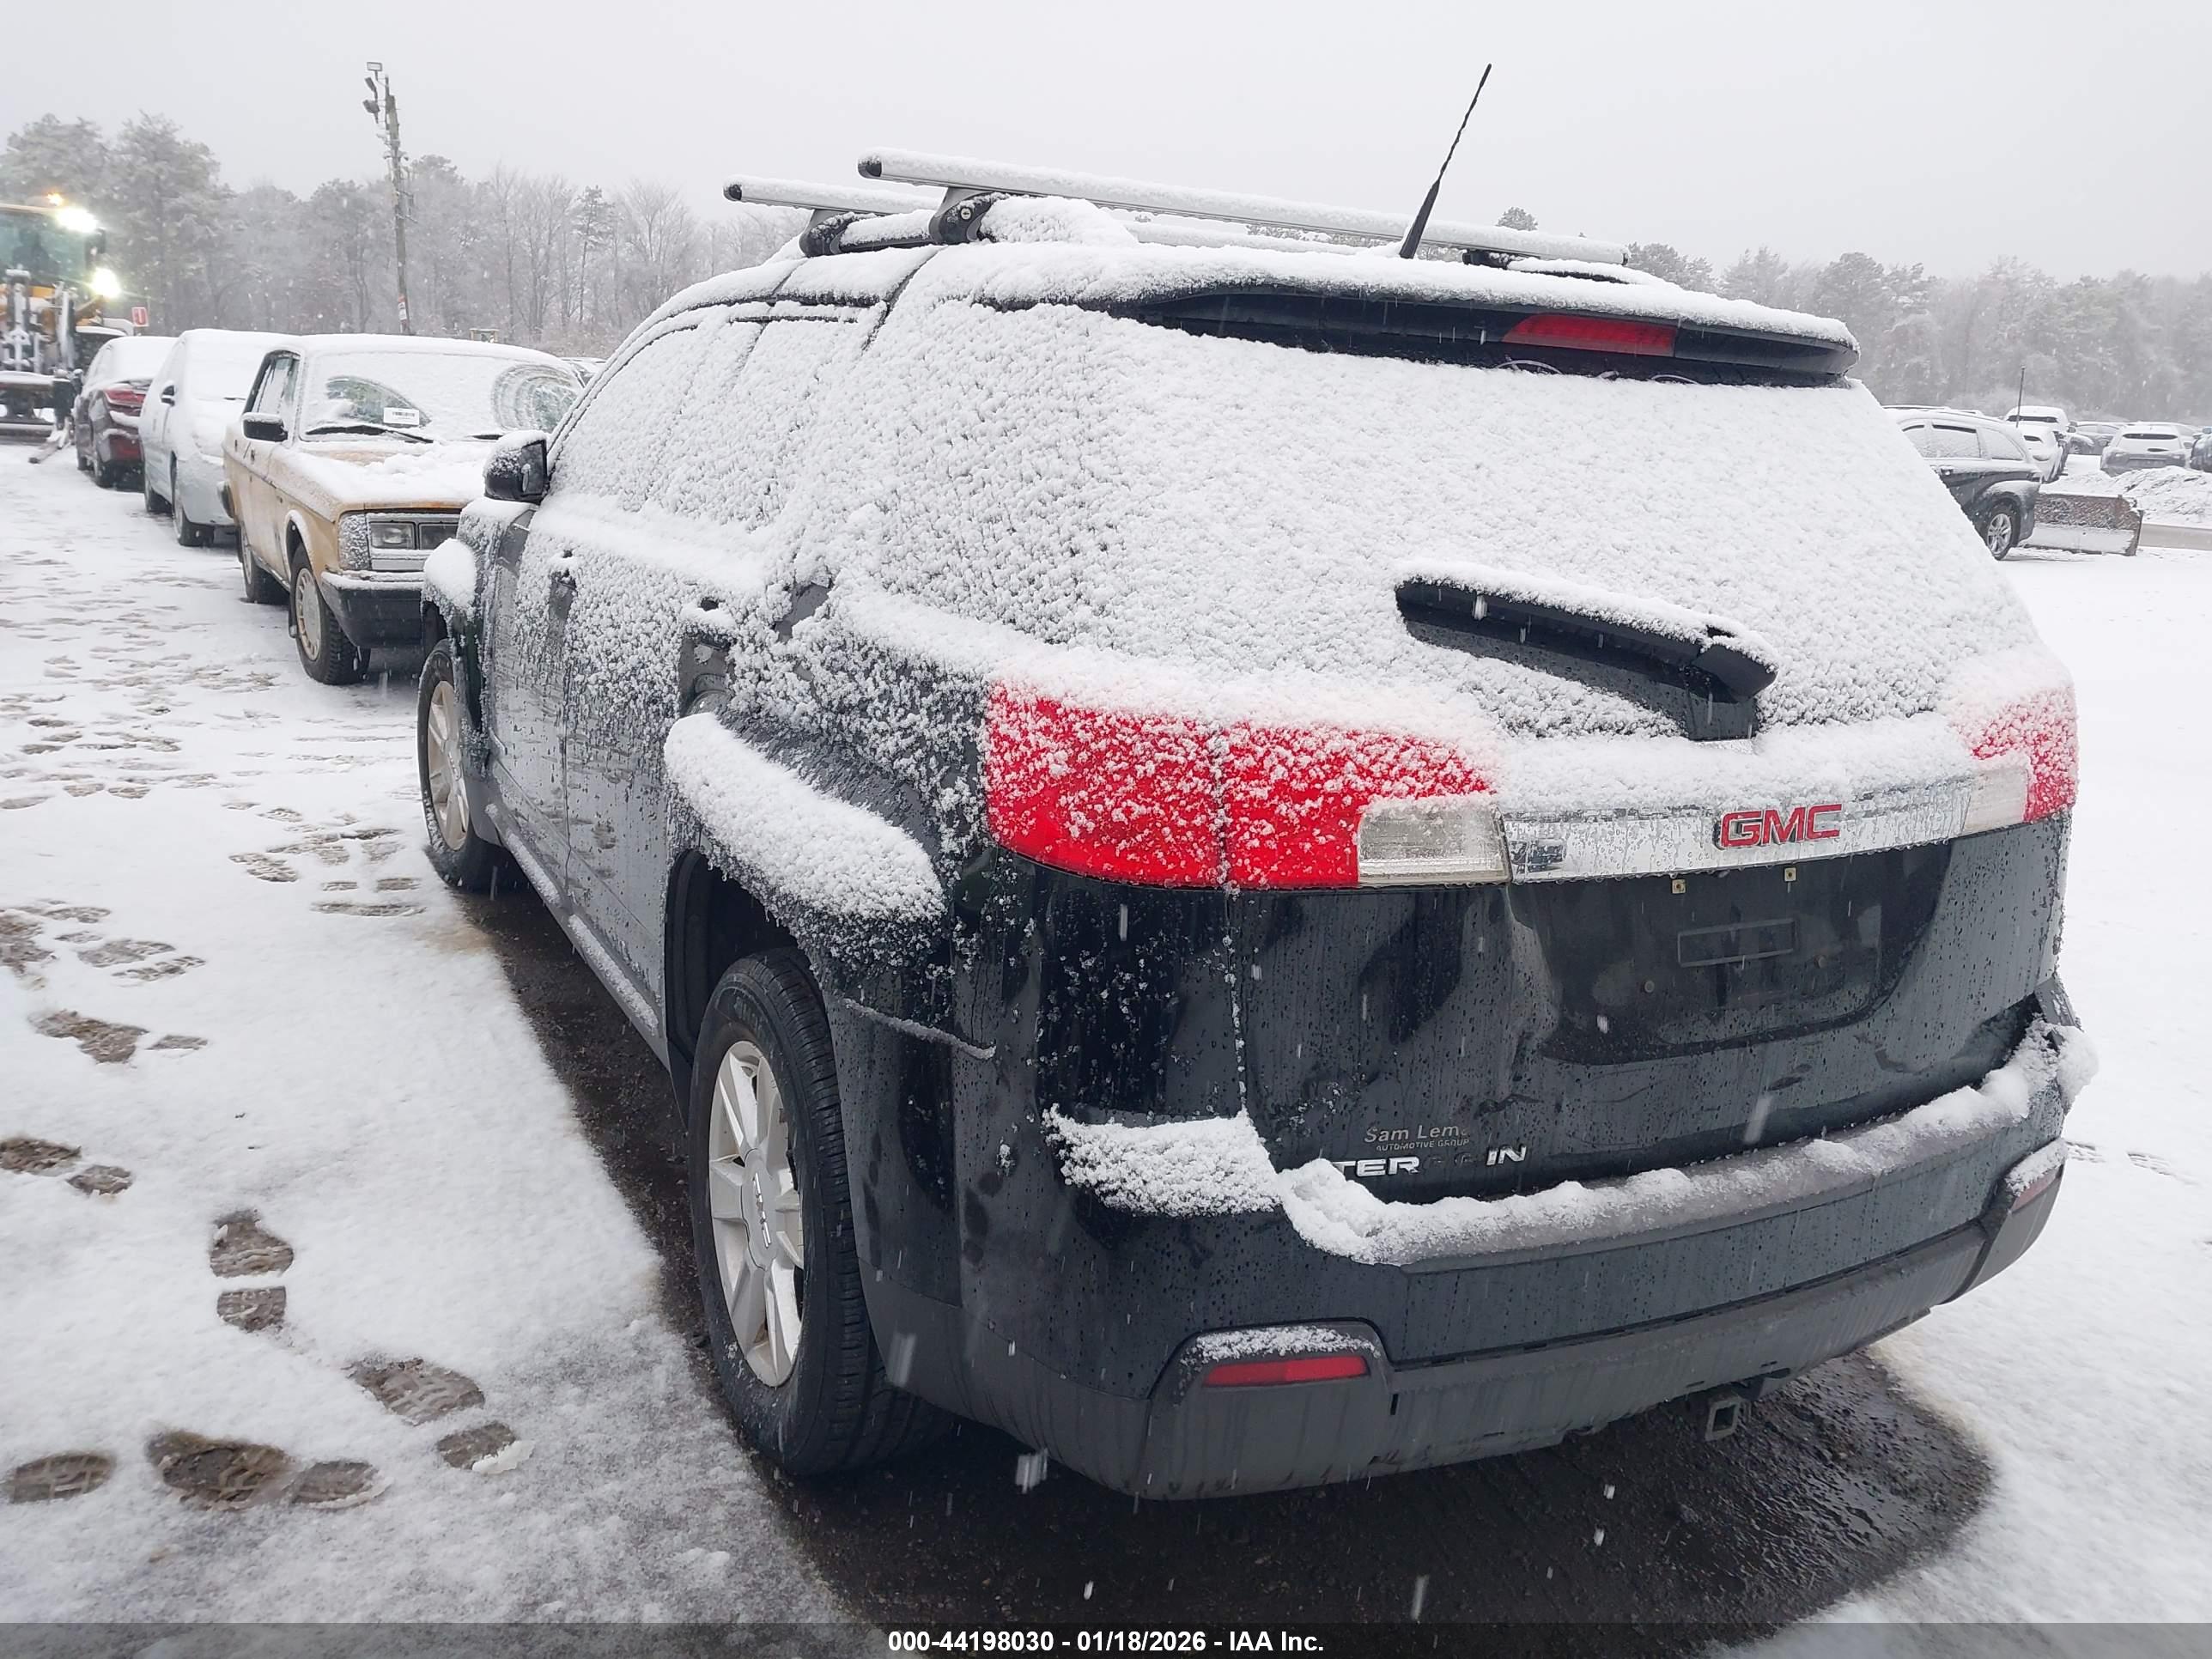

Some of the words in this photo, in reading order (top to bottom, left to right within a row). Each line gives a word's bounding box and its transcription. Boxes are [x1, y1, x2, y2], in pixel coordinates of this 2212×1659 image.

[1720, 803, 1843, 848] GMC
[1364, 1127, 1409, 1143] Sam
[1376, 1140, 1435, 1152] AUTOMOTIVE
